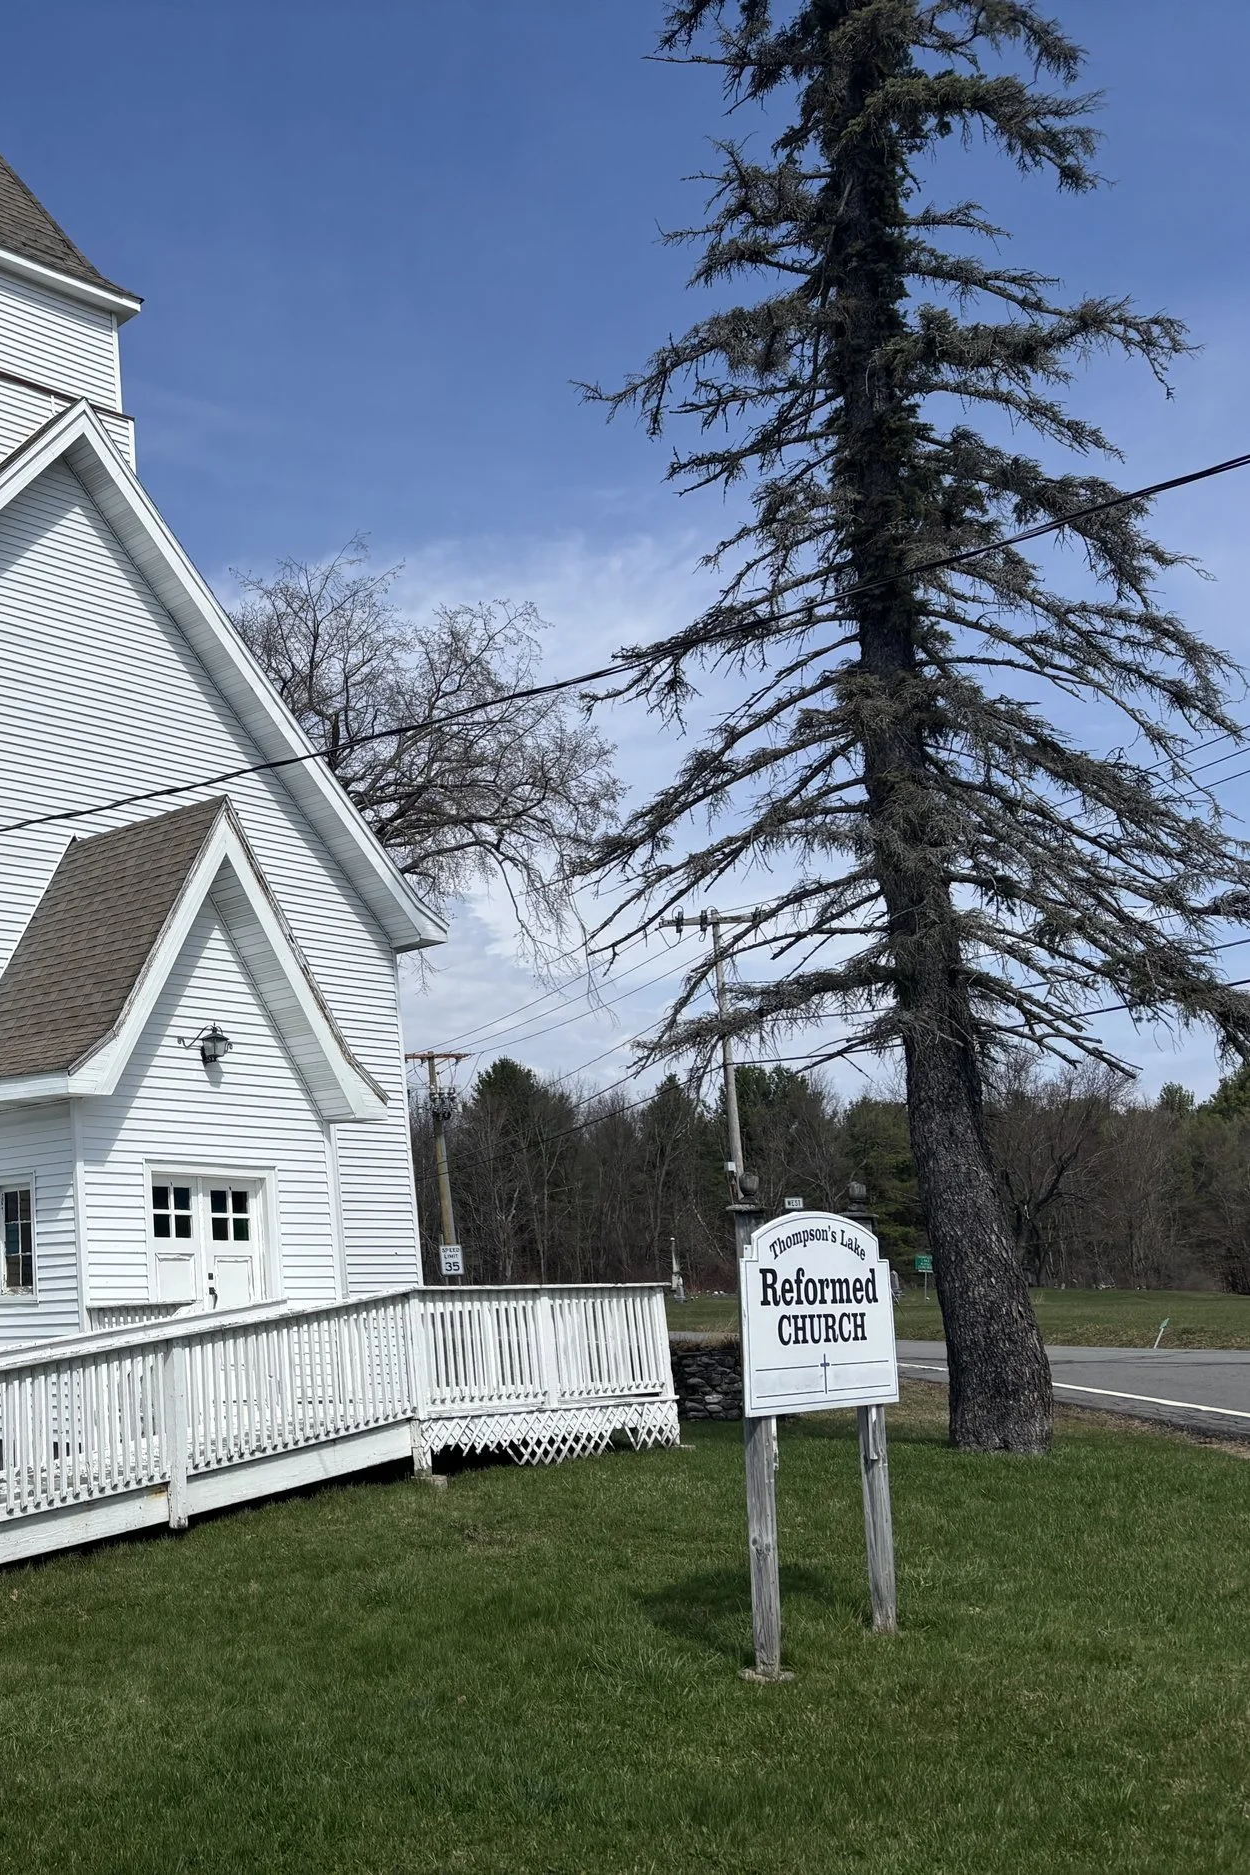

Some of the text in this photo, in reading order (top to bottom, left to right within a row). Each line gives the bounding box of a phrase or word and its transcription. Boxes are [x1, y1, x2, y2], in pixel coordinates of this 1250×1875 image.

[769, 1225, 866, 1261] Thompson's Lake
[445, 1261, 460, 1271] 35
[759, 1267, 879, 1306] Reformed
[778, 1312, 868, 1346] CHURCH
